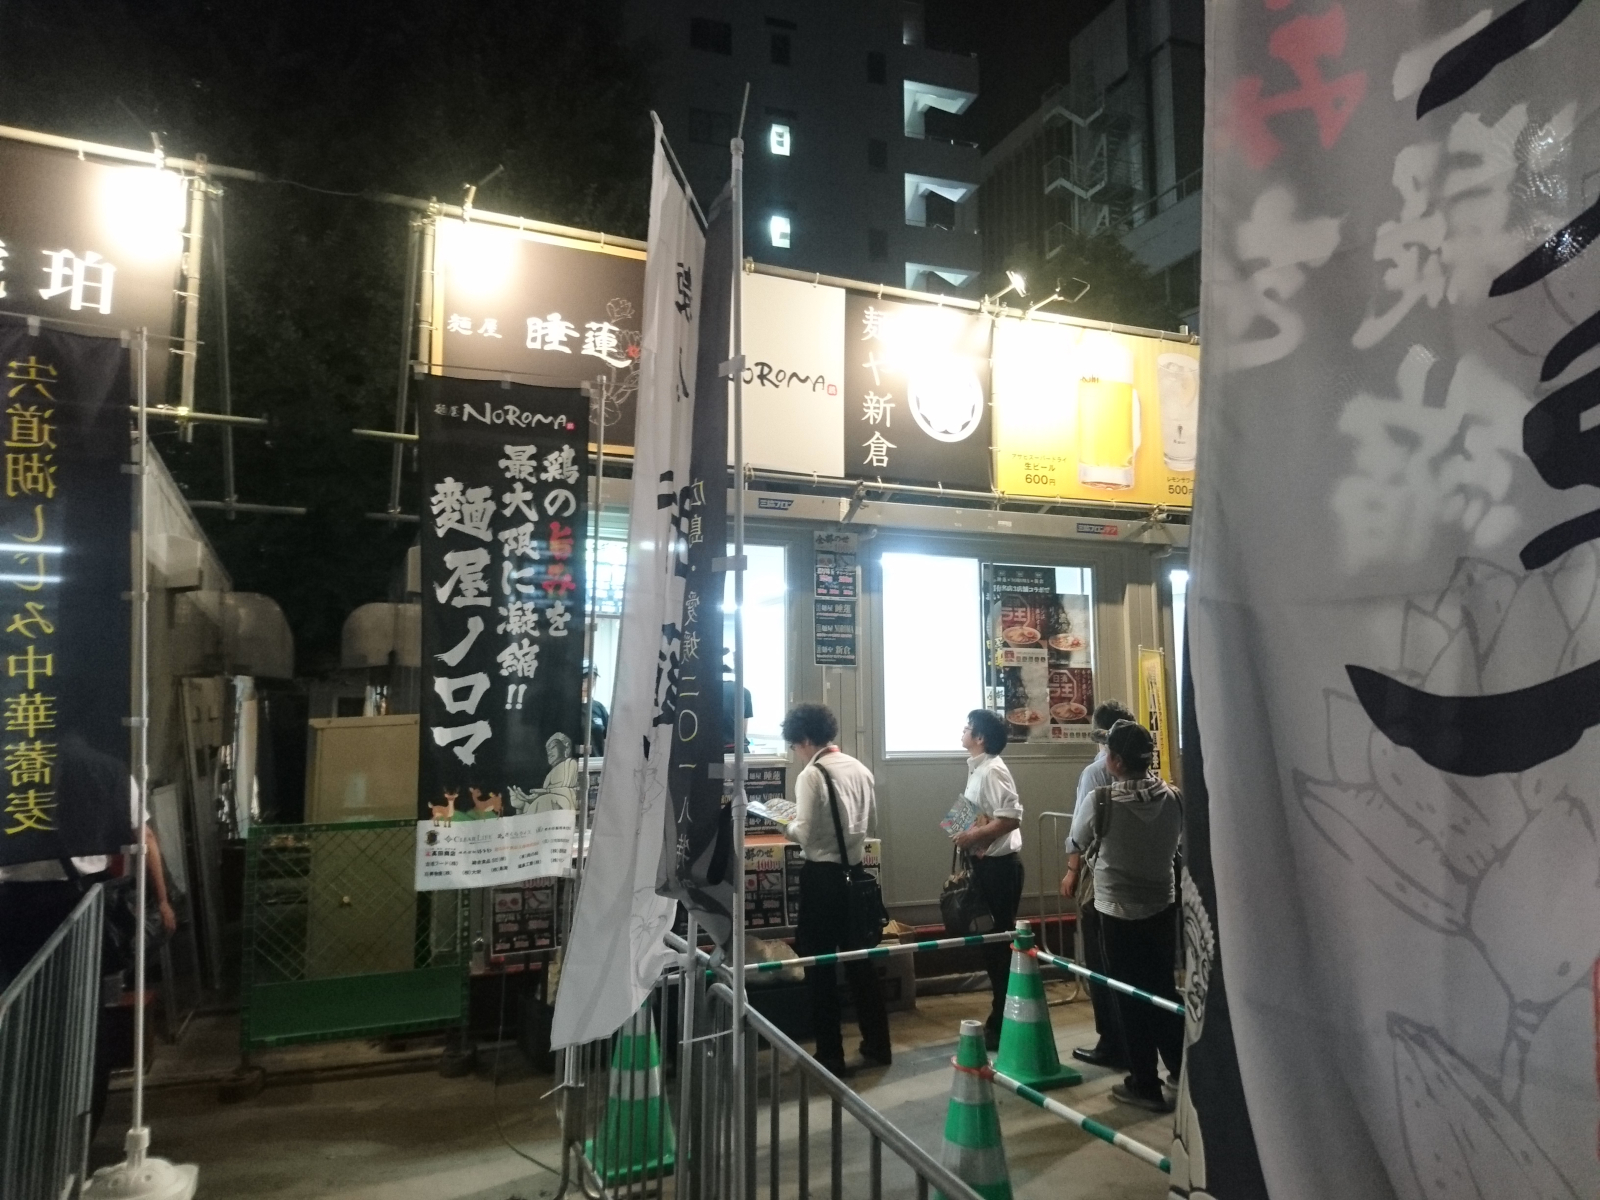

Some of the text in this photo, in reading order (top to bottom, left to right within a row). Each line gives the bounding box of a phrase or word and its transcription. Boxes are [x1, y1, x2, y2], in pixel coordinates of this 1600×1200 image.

[526, 312, 632, 369] 睡蓮
[1024, 462, 1056, 472] 生ビール
[1025, 473, 1056, 486] 600円
[540, 444, 579, 637] 鶏の旨みを
